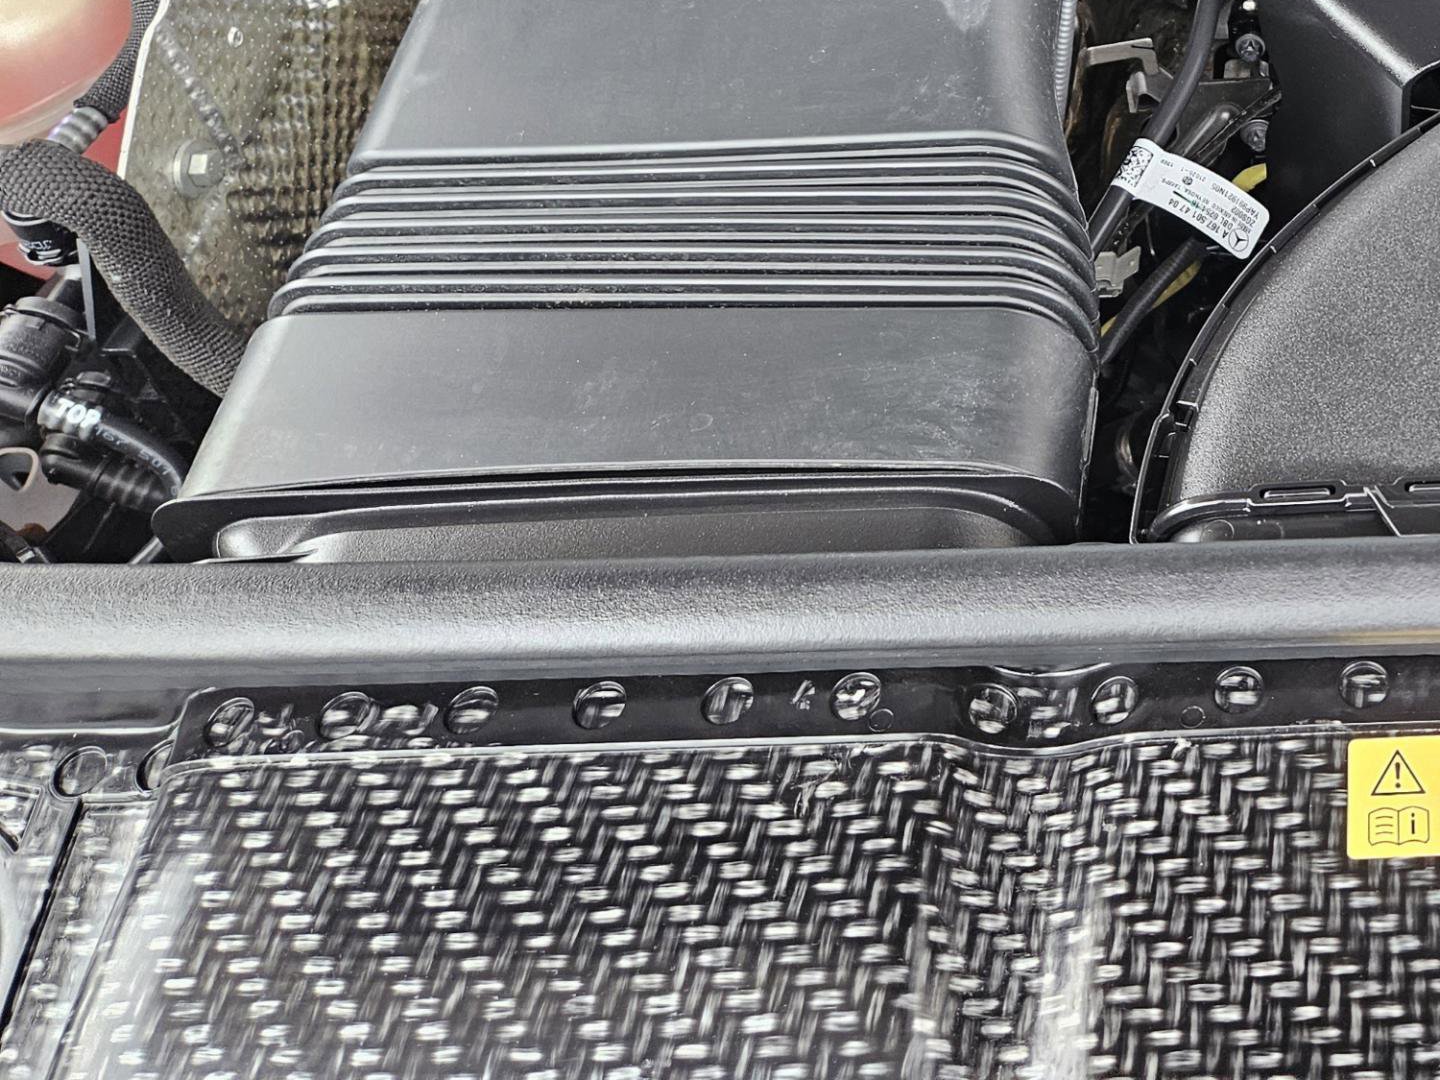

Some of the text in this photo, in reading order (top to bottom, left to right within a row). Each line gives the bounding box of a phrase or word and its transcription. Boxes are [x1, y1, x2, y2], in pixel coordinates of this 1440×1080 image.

[1179, 204, 1190, 214] 47
[1191, 211, 1206, 224] 501
[1206, 220, 1221, 233] 167
[1220, 229, 1228, 238] A
[55, 397, 101, 426] TOP
